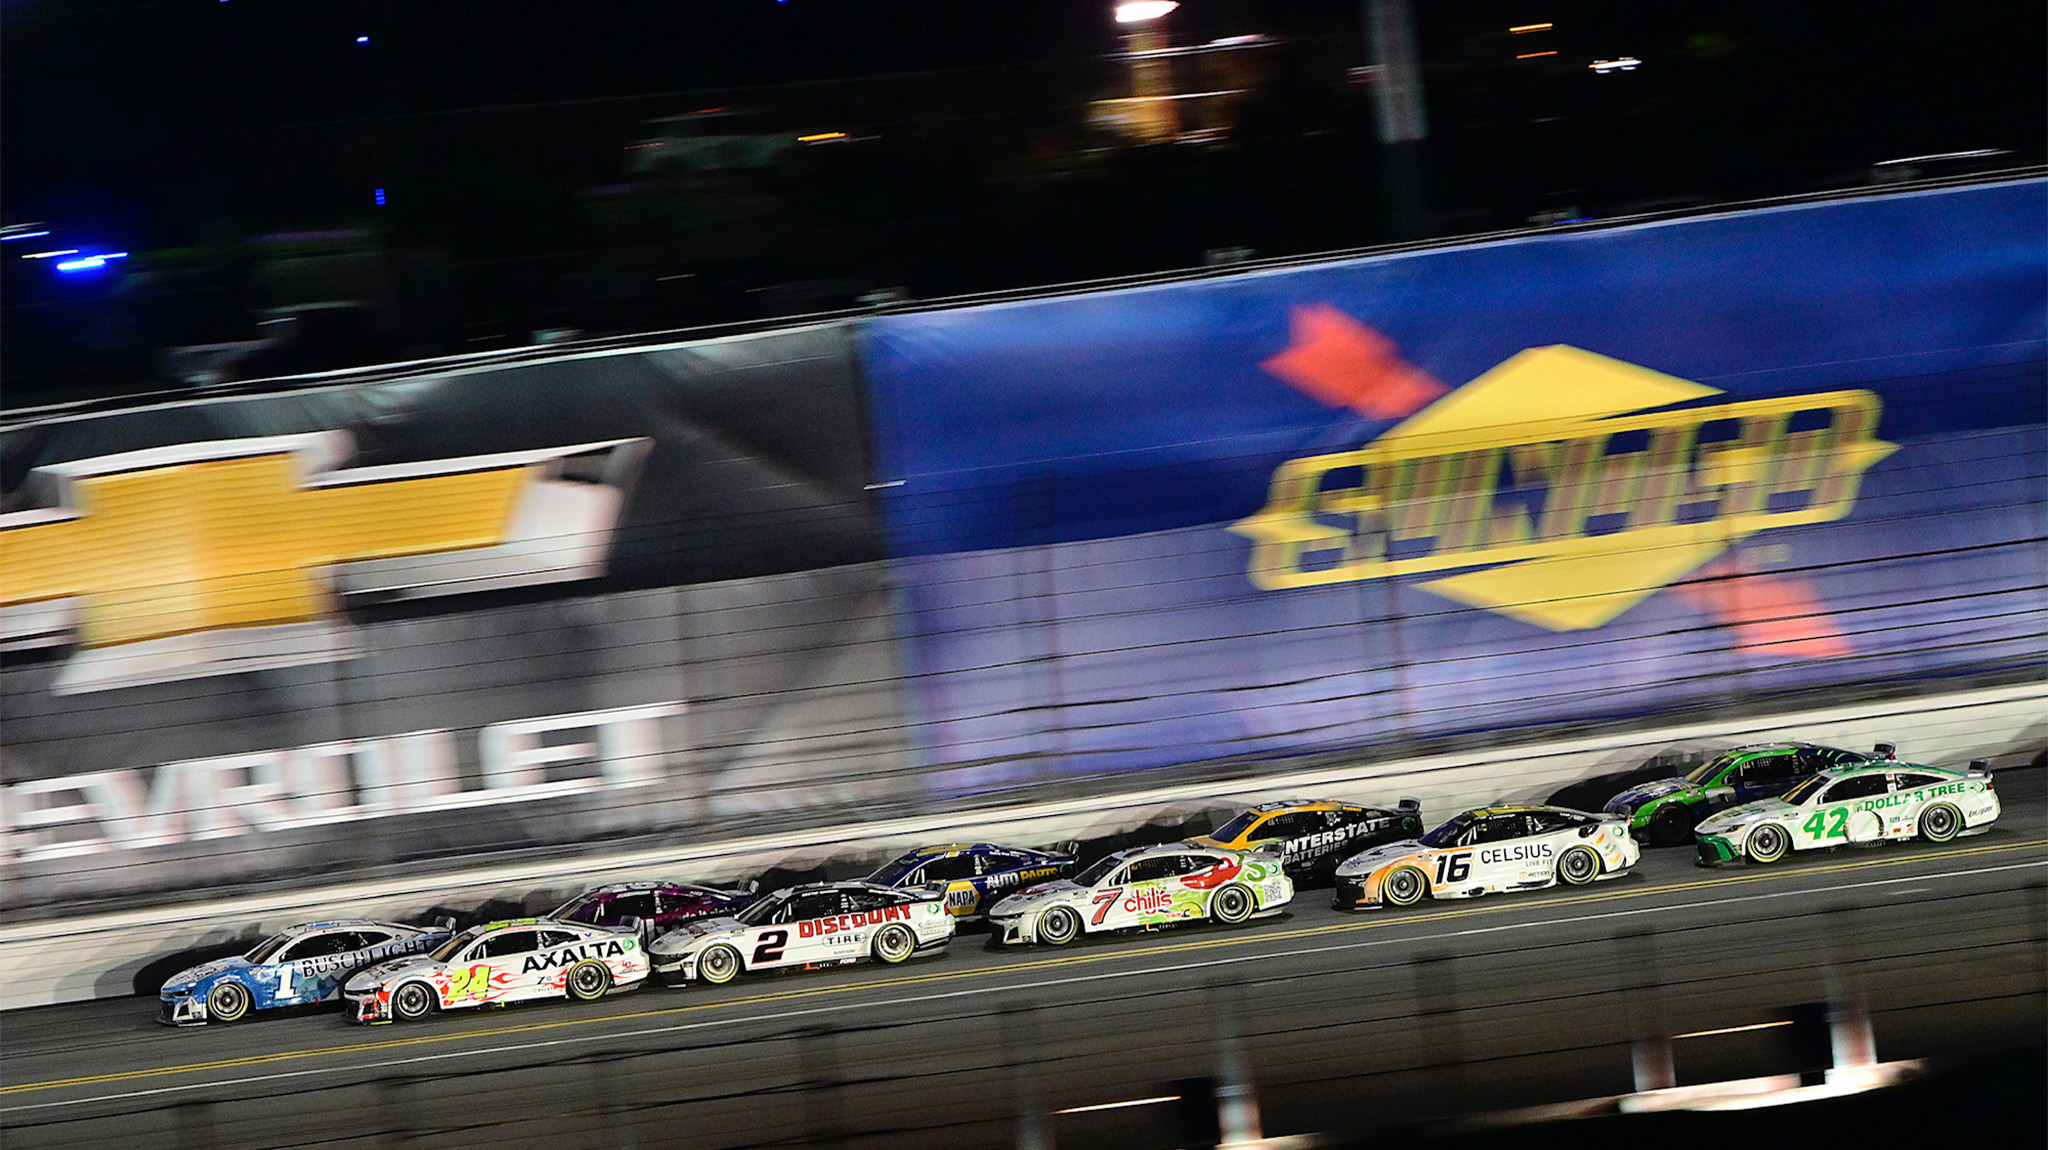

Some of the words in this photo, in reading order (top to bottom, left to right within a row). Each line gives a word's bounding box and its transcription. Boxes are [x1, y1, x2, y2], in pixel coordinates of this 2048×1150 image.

[1865, 791, 1924, 811] DOLLAR
[1928, 783, 1965, 798] TREE
[1283, 817, 1390, 855] NTERSTATE
[1803, 807, 1849, 840] 42
[1283, 840, 1348, 865] BATTERIES
[1434, 851, 1472, 885] 16
[1481, 844, 1552, 864] CELSIUS
[986, 872, 1019, 889] AUTO
[1020, 867, 1058, 884] PARTS
[948, 889, 976, 907] NAPA
[1091, 887, 1123, 925] 7
[798, 904, 912, 938] DISCOUNT
[751, 930, 788, 964] 2
[827, 934, 862, 945] TIRE
[301, 951, 365, 979] BUSCH
[522, 940, 624, 974] AXALTA
[273, 962, 297, 1000] 1
[448, 966, 492, 1002] 24
